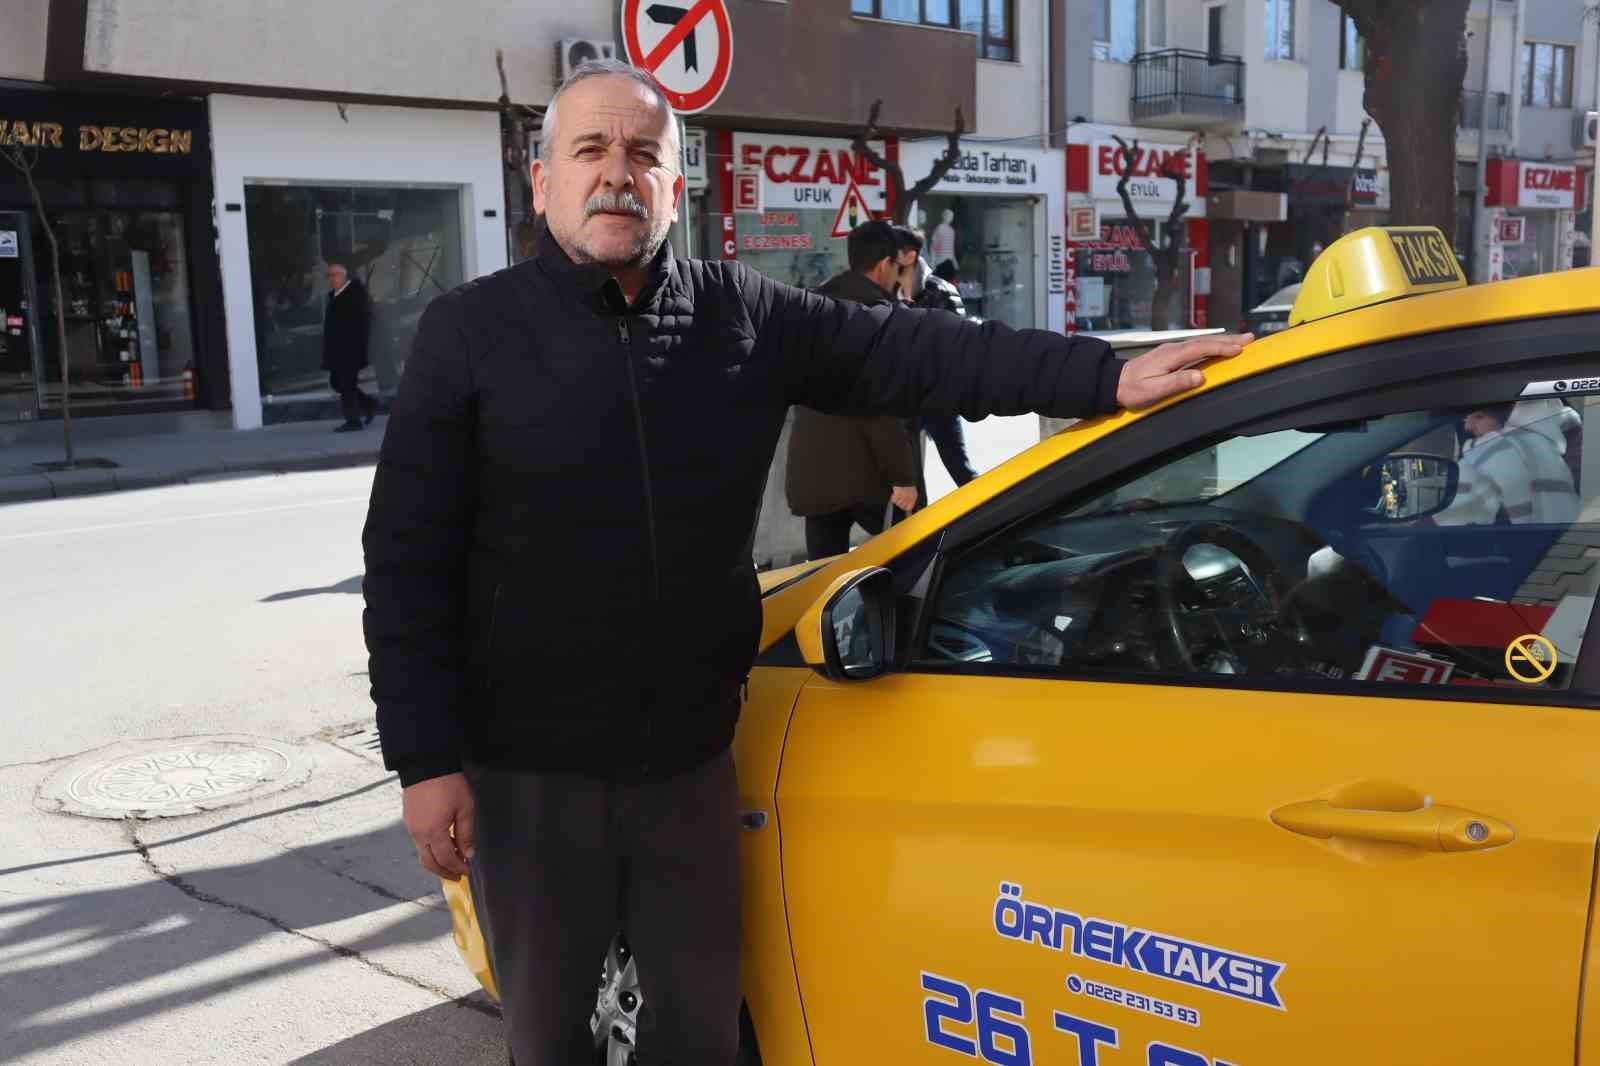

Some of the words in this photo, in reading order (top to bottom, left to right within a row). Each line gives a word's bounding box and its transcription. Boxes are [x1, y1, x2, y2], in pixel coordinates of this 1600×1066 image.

[79, 125, 193, 154] DESIGN
[742, 144, 881, 186] ECZANE
[1098, 145, 1192, 180] ECZANE
[794, 187, 832, 203] UFUK
[1130, 181, 1160, 198] EYLÜL
[994, 881, 1145, 971] ÖRNEK
[920, 973, 1033, 1066] 26
[1053, 1011, 1119, 1066] T
[1085, 981, 1122, 1003] 0222
[1126, 993, 1150, 1011] 231
[1154, 1000, 1174, 1018] 53
[1178, 1007, 1198, 1025] 93
